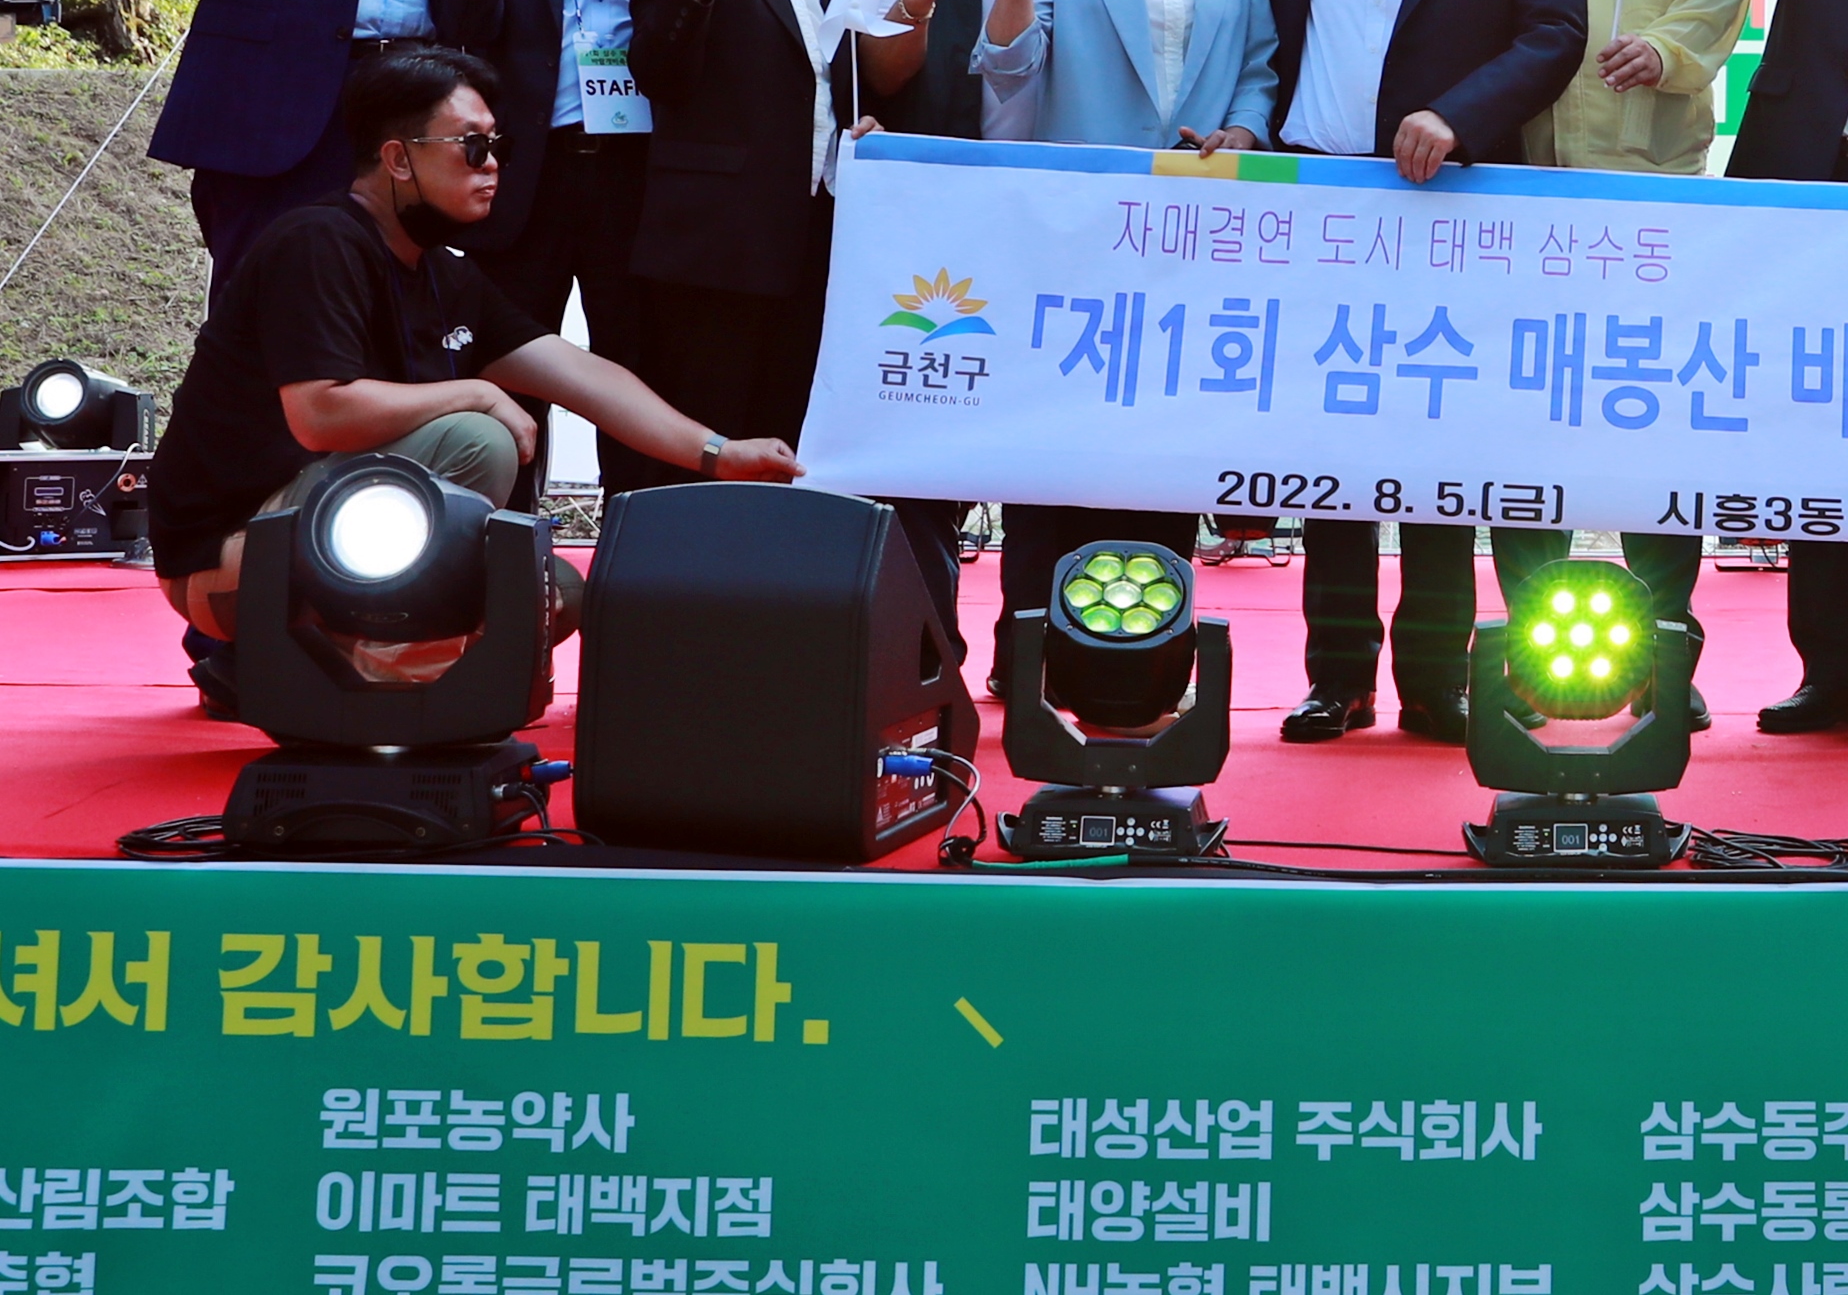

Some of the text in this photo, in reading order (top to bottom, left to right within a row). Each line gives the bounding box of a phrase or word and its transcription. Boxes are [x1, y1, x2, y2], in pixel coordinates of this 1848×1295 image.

[1113, 202, 1671, 282] 자매결연 도시 태백 삼수동
[878, 351, 990, 391] 금천구
[878, 391, 981, 406] GEUMCHEON-GU
[1314, 304, 1478, 419] 삼수
[1510, 313, 1759, 431] 매봉산
[1216, 470, 1564, 524] 2022. 8. 5.(금)
[1561, 834, 1580, 845] 001
[221, 934, 828, 1043] 감사합니다.
[321, 1089, 635, 1153] 원포농약사
[1030, 1098, 1542, 1160] 태성산업 주식회사
[317, 1172, 772, 1237] 이마트 태백지점
[1028, 1180, 1270, 1241] 태양설비
